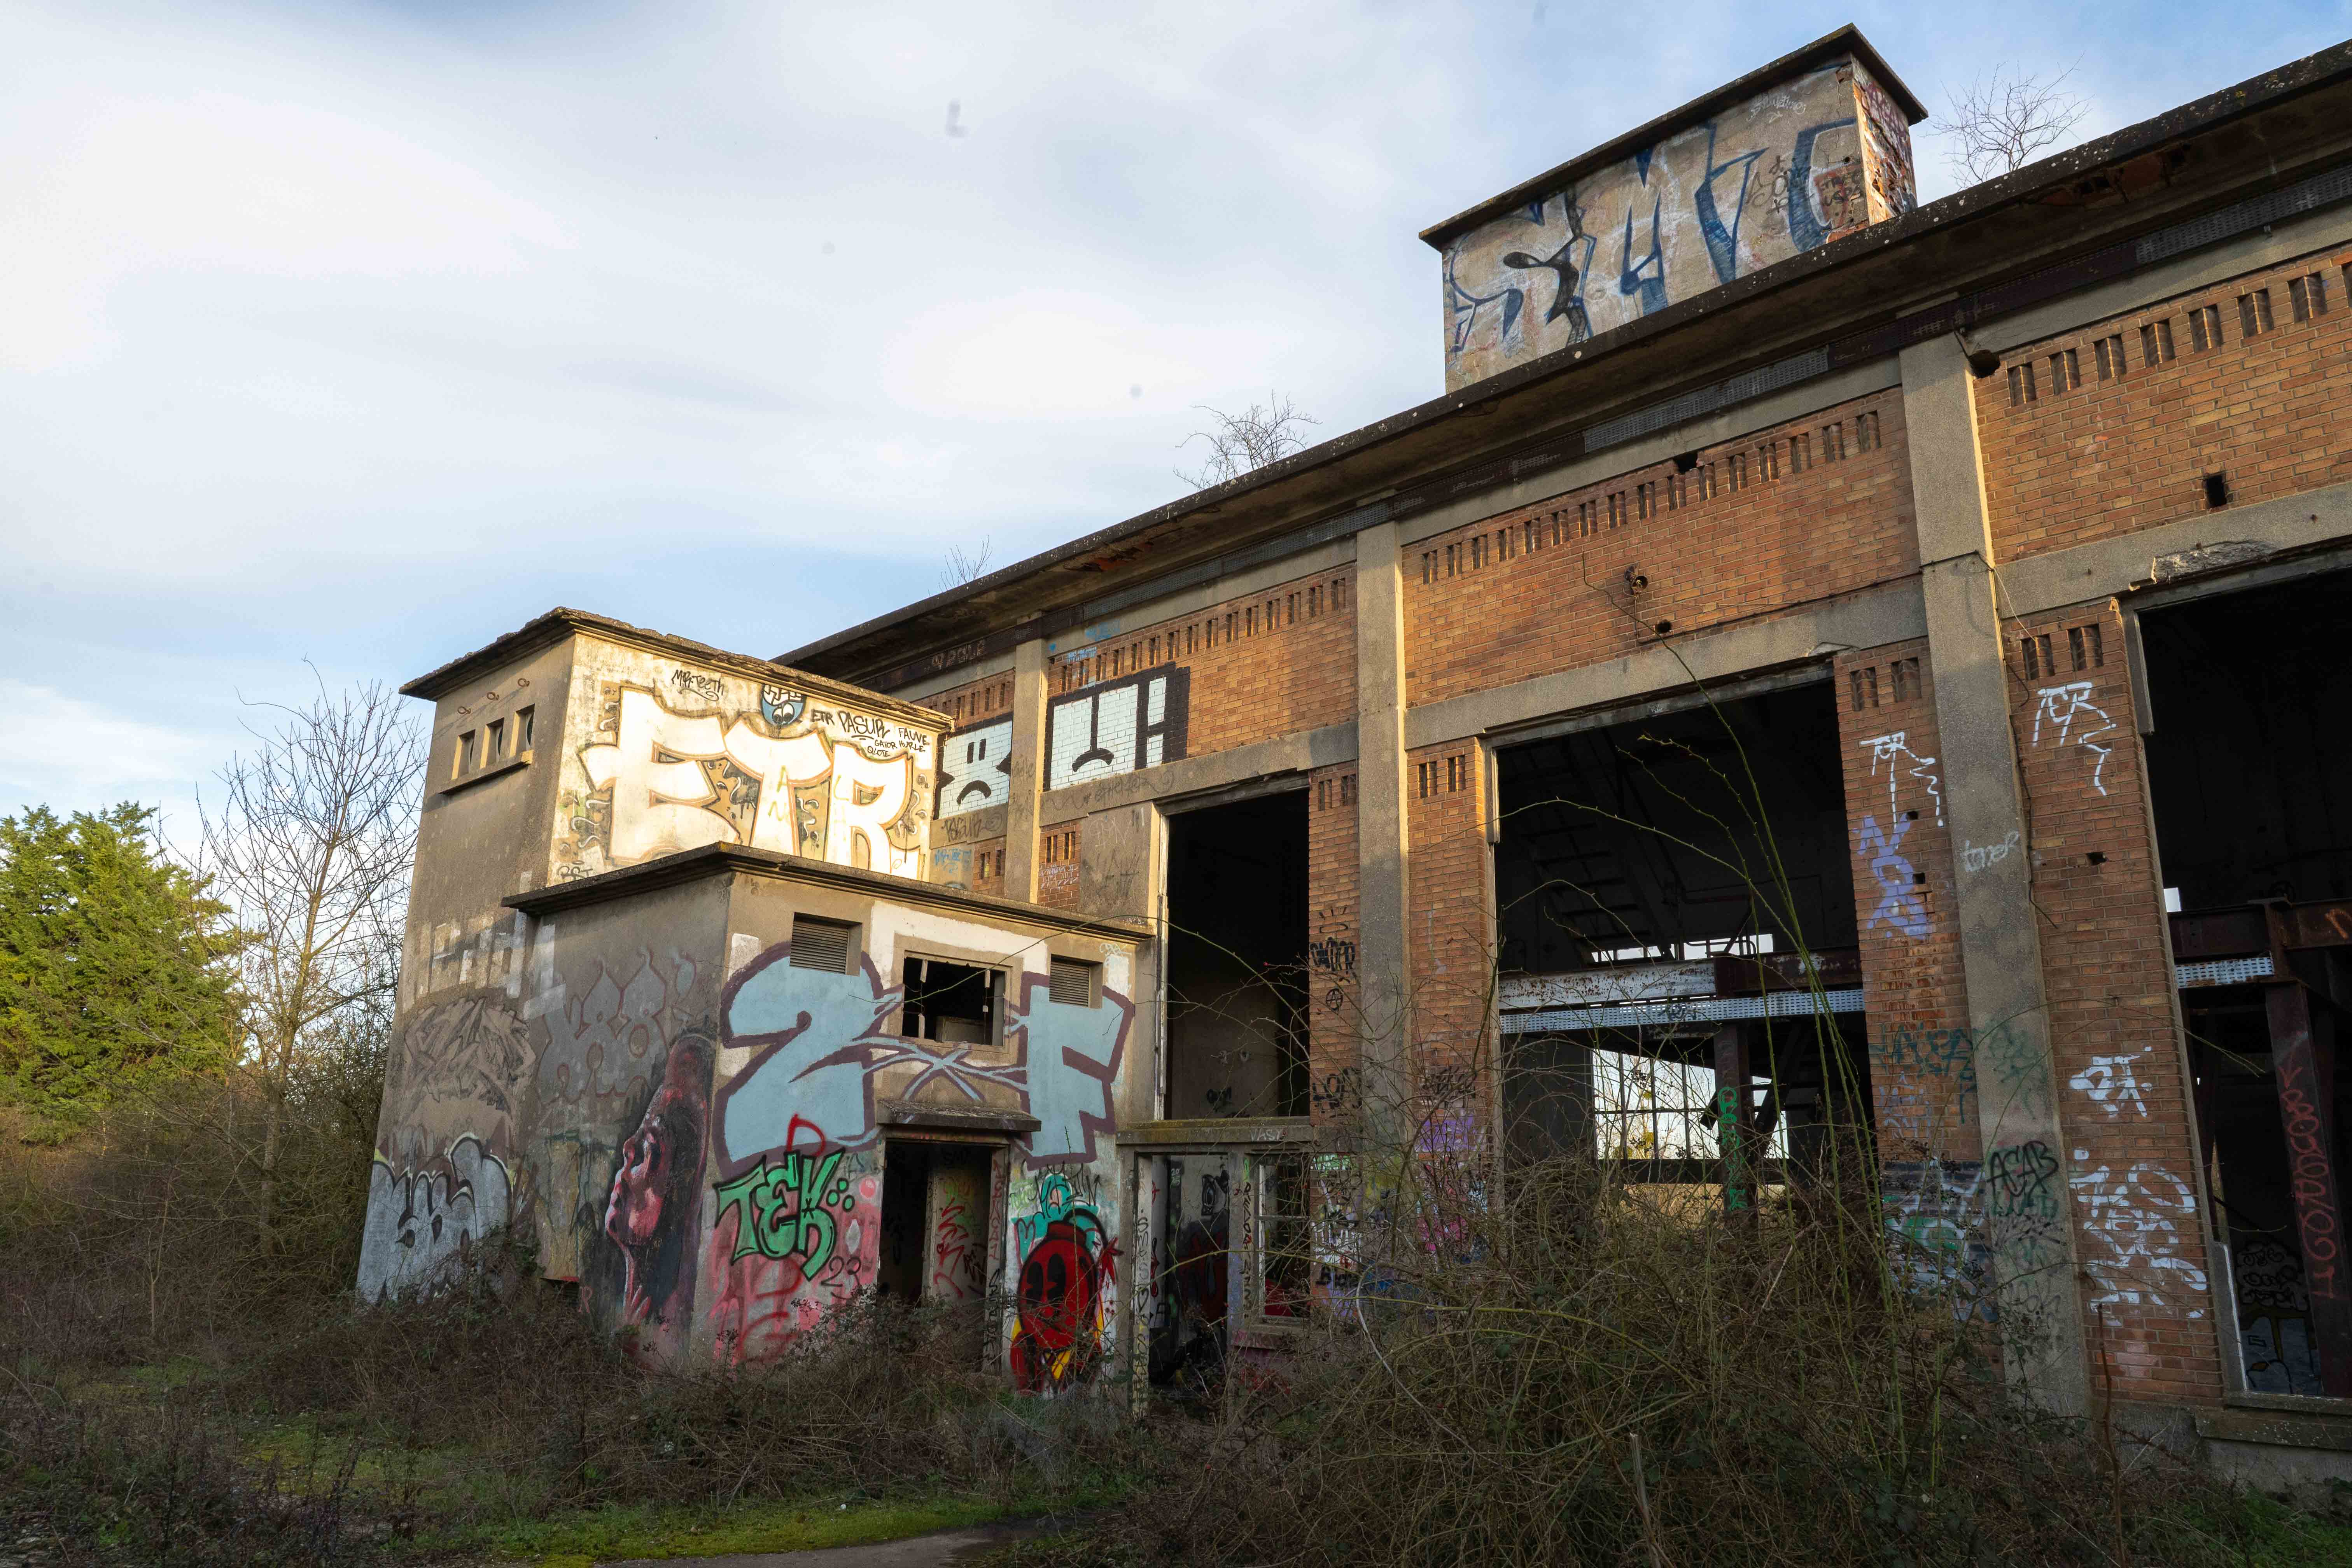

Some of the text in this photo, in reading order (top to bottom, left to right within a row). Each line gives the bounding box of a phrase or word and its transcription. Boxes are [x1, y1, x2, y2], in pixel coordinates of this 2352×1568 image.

[811, 709, 835, 726] ETR
[898, 727, 929, 745] FAUVE
[874, 739, 926, 752] GATOR HURLE
[1986, 1140, 2060, 1202] ACAB
